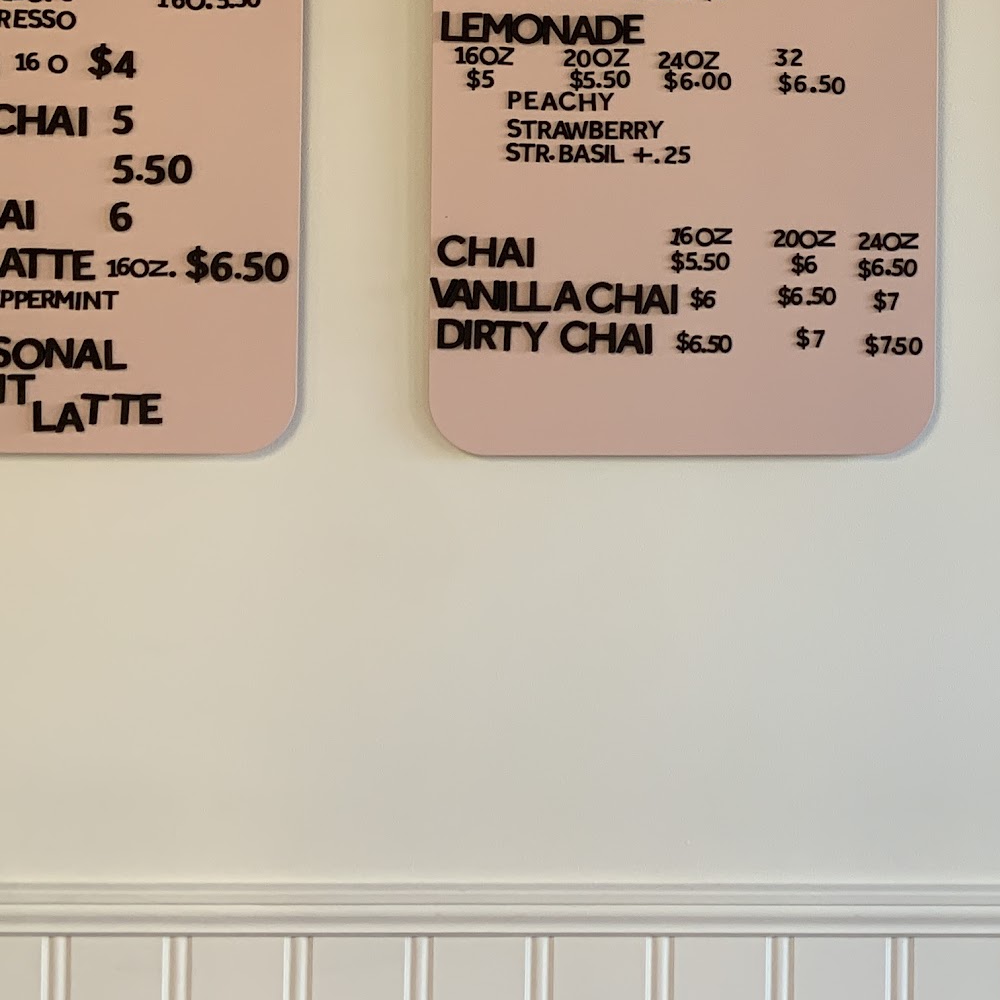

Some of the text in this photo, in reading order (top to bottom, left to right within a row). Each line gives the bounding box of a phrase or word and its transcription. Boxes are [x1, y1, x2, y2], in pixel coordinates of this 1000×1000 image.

[440, 10, 646, 46] LEMONADE
[87, 42, 137, 81] $4
[454, 46, 803, 69] 16OZ 20OZ 24OZ 32
[466, 67, 846, 96] $5 $5.50 $6.00 $6.50
[507, 92, 615, 112] PEACHY
[111, 104, 134, 135] 5
[506, 118, 665, 141] STRAWBERRY
[111, 154, 193, 186] 5.50
[109, 201, 133, 233] 6
[185, 245, 290, 284] $6.50
[436, 234, 535, 268] CHAI
[772, 228, 837, 250] 20OZ
[857, 231, 920, 252] 24OZ
[670, 249, 918, 282] $5.50 $6 $6.50
[429, 276, 900, 315] VANILLA CHAI $6 $6.50 $7
[436, 318, 549, 353] DIRTY
[559, 320, 653, 355] CHAI
[675, 329, 733, 354] $6.50
[795, 325, 826, 351] $7
[32, 392, 163, 434] LATTE
